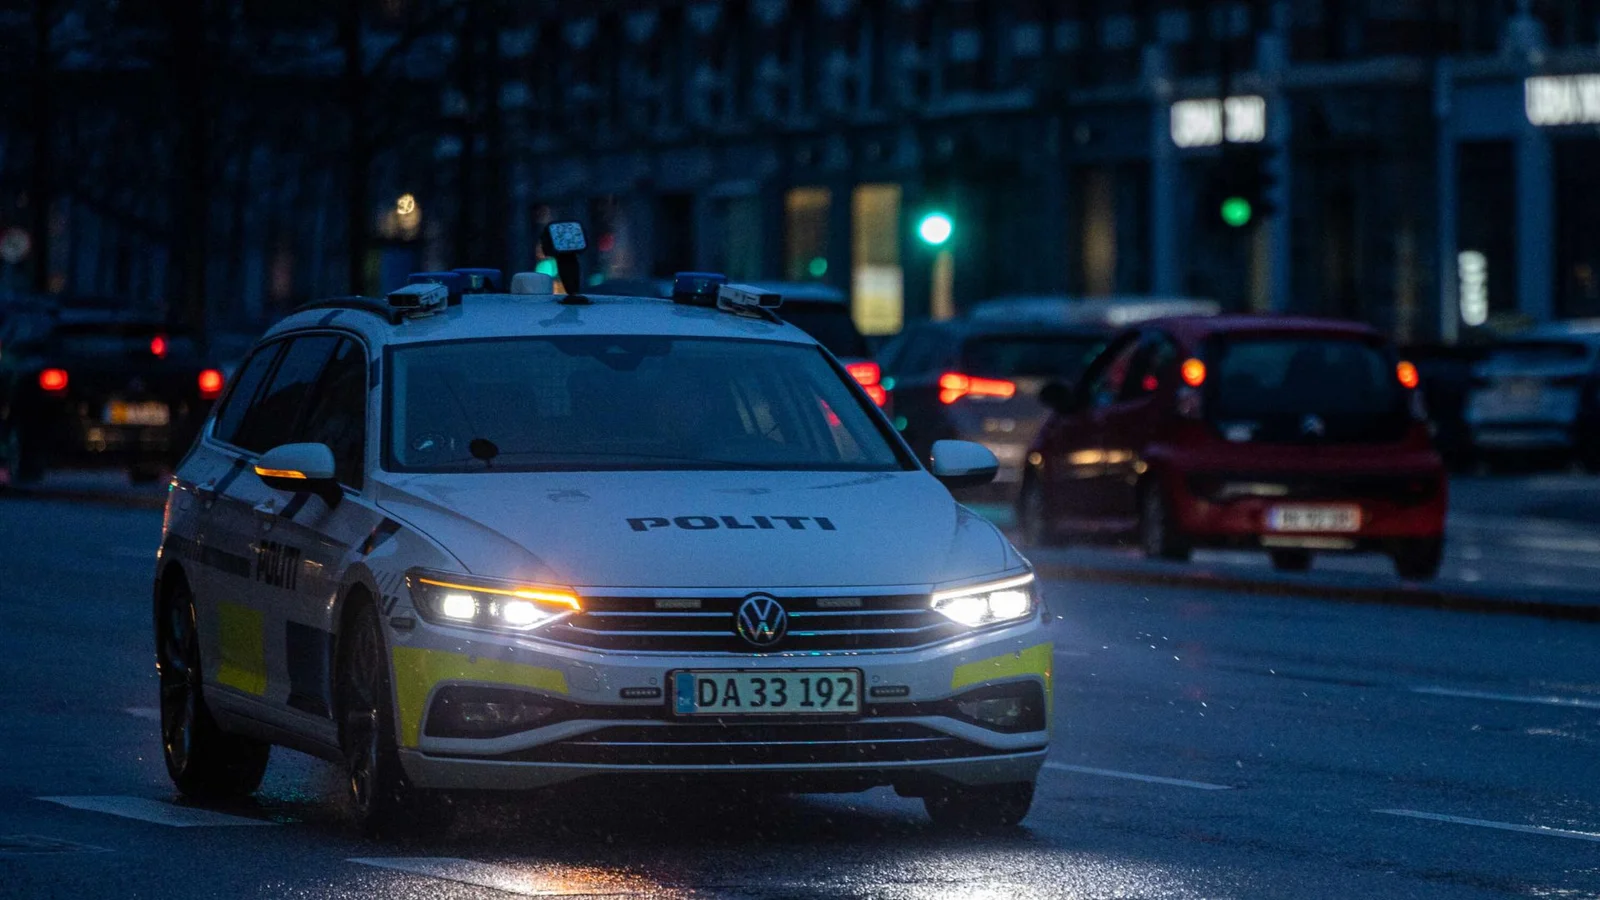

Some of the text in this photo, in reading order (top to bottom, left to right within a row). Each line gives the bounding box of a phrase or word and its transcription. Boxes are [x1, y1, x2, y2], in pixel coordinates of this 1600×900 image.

[626, 515, 836, 532] POLITI
[257, 539, 300, 590] POLITI
[699, 677, 855, 708] DA 33 192
